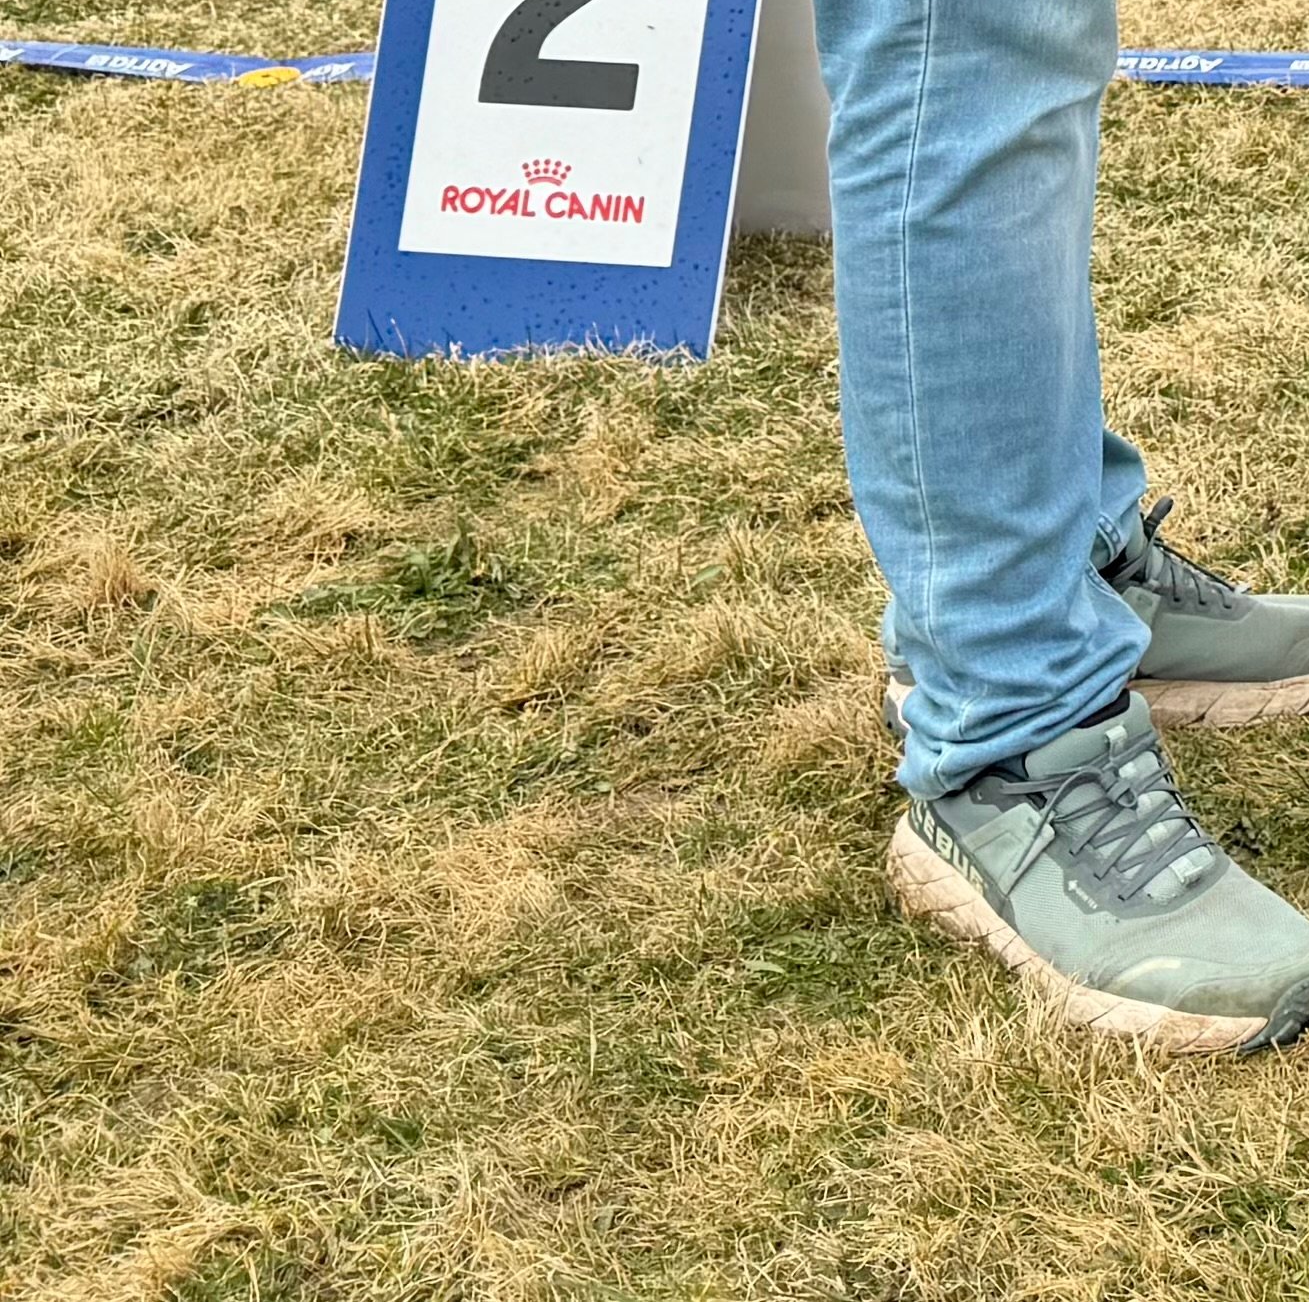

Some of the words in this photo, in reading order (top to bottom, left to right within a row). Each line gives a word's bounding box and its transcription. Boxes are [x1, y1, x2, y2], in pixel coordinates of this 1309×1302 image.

[108, 54, 195, 77] Agria
[1139, 56, 1224, 75] Agria
[439, 184, 536, 218] ROYAL
[544, 192, 645, 225] CANIN
